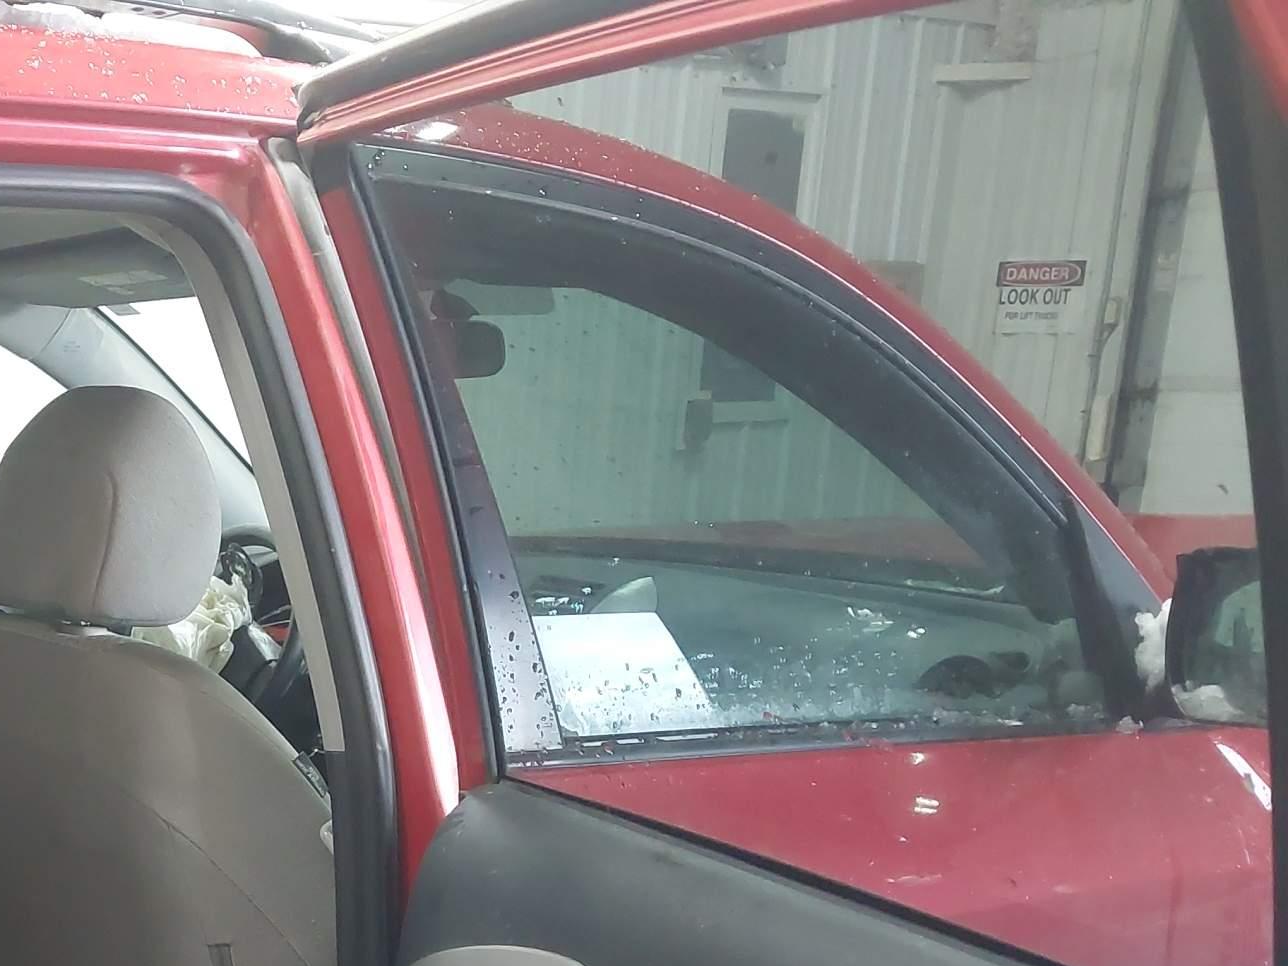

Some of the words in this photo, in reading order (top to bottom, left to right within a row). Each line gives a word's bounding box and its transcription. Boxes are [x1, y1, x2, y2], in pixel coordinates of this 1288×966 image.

[1006, 267, 1070, 281] DANGER
[999, 288, 1039, 305] LOOK
[1043, 288, 1071, 305] OUT
